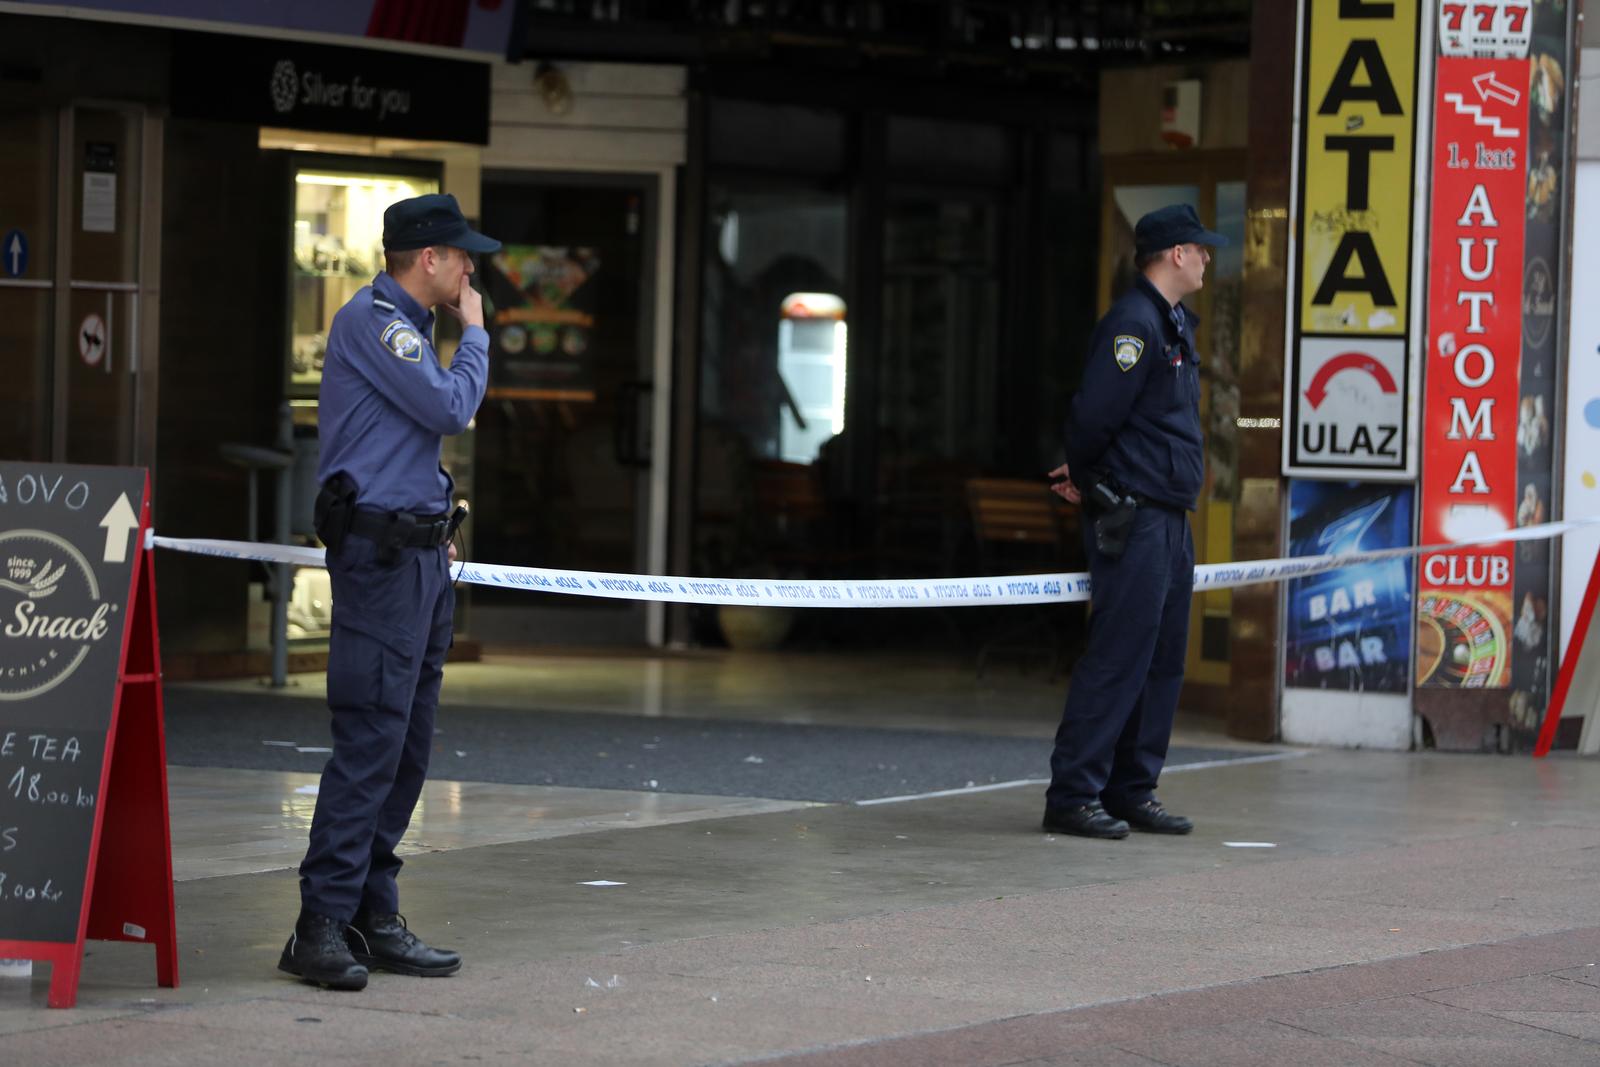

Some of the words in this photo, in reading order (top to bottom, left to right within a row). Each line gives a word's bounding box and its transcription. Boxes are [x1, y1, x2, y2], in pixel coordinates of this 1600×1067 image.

[302, 71, 347, 107] Silver
[352, 76, 377, 110] for
[379, 89, 411, 121] you
[1311, 0, 1404, 307] ATA
[1448, 143, 1470, 169] 1.
[1475, 142, 1516, 170] kat
[1302, 424, 1398, 456] ULAZ
[9, 568, 32, 578] 1999
[502, 572, 553, 587] POLICIJA
[555, 576, 583, 590] STOP
[1424, 554, 1510, 586] CLUB
[599, 578, 645, 593] POLICIJA
[647, 580, 674, 594] STOP
[736, 584, 760, 598] STOP
[819, 585, 841, 600] STOP
[1043, 581, 1061, 595] STOP
[1308, 579, 1378, 622] BAR
[5, 600, 109, 641] Snack
[1314, 636, 1388, 673] BAR
[28, 734, 81, 762] TEA
